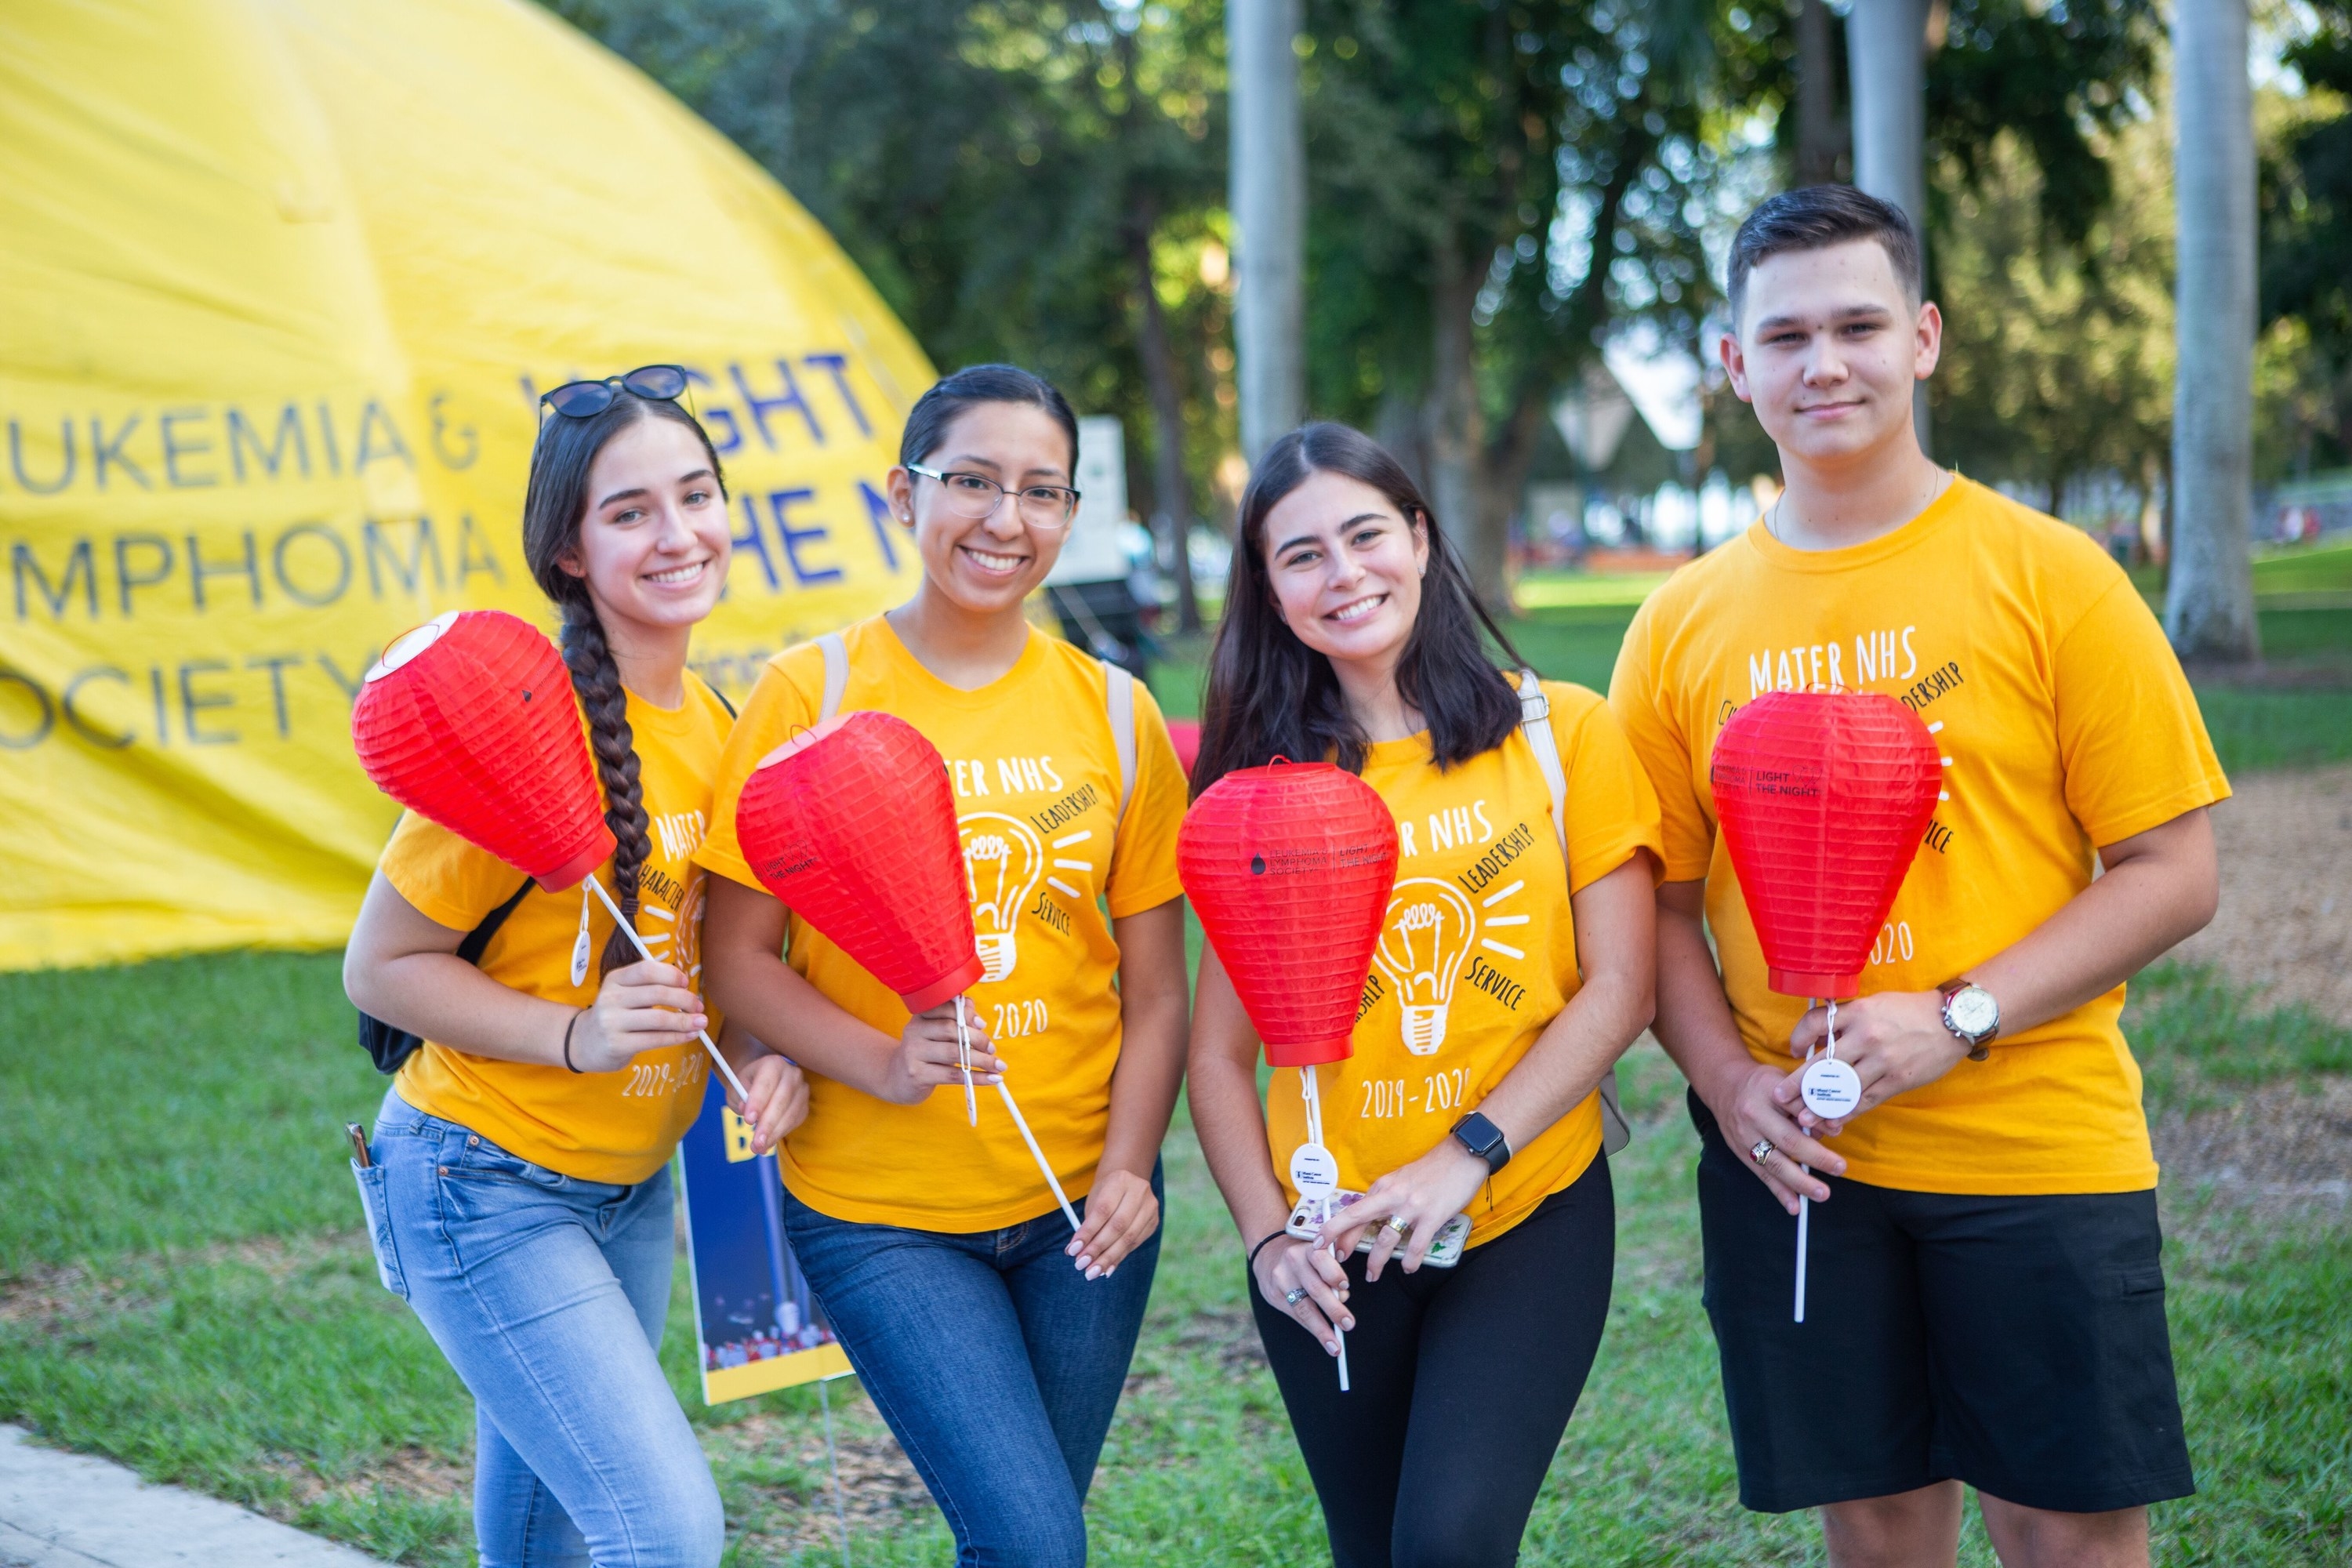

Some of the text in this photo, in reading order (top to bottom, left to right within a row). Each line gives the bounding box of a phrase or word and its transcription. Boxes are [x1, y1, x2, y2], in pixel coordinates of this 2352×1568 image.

[1749, 626, 1918, 699] MATER NHS
[943, 755, 1064, 797] ER NHS
[1756, 771, 1790, 783] LIGHT
[1756, 783, 1818, 797] THE NIGHT
[1030, 784, 1098, 834] LEADERSHIP
[1429, 800, 1494, 853] NHS
[1269, 856, 1327, 866] LYMPHOMA
[1340, 844, 1367, 857] LIGHT
[1340, 852, 1387, 869] THE NIGHT
[1457, 822, 1535, 894] LEADERSHIP
[764, 857, 786, 872] LIGHT
[769, 859, 815, 881] THE NIGHT
[1269, 867, 1314, 876] SOCIETY
[1031, 892, 1071, 937] SERVICE
[1464, 956, 1526, 1011] SERVICE
